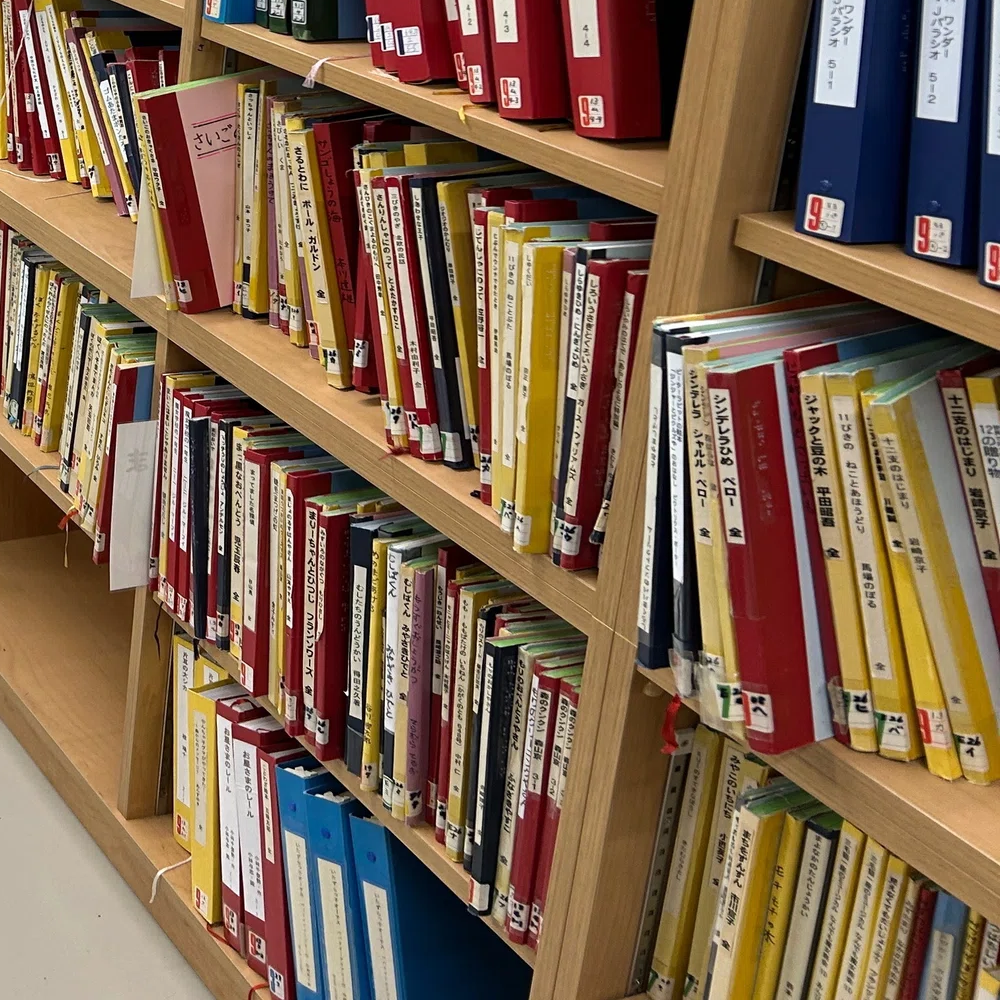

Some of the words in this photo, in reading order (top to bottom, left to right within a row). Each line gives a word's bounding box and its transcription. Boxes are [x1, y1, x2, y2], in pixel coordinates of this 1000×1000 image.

[840, 3, 856, 46] ワンダー
[940, 14, 955, 58] ワンダー
[293, 146, 310, 192] さるとわに
[316, 289, 326, 300] 全
[807, 195, 821, 231] 9
[917, 215, 930, 252] 9
[579, 278, 598, 390] しろいうさぎとくろいうさぎ
[687, 368, 702, 420] シンデレラ
[803, 393, 828, 477] ジャックと豆の木
[692, 427, 708, 509] シャルル・ペロー
[713, 393, 735, 466] シンデレラひめ
[728, 525, 744, 540] 全
[946, 393, 977, 478] 十二支のはじまり
[982, 548, 998, 562] 全
[698, 526, 711, 539] 全
[816, 485, 837, 528] 平田昭吾
[305, 509, 318, 605] まりーちゃんとひつじ
[826, 546, 841, 560] 全
[844, 459, 866, 536] ねことあほうどり
[859, 561, 878, 610] 馬場のぼる
[874, 661, 886, 673] 全
[881, 436, 911, 511] 十二支のはじまり
[950, 694, 962, 705] 全
[891, 538, 904, 550] 全
[353, 583, 366, 664] むしたちのうんどうかい
[401, 576, 412, 618] むしばくん
[303, 684, 313, 697] 全
[241, 749, 255, 819] お星さまのレール
